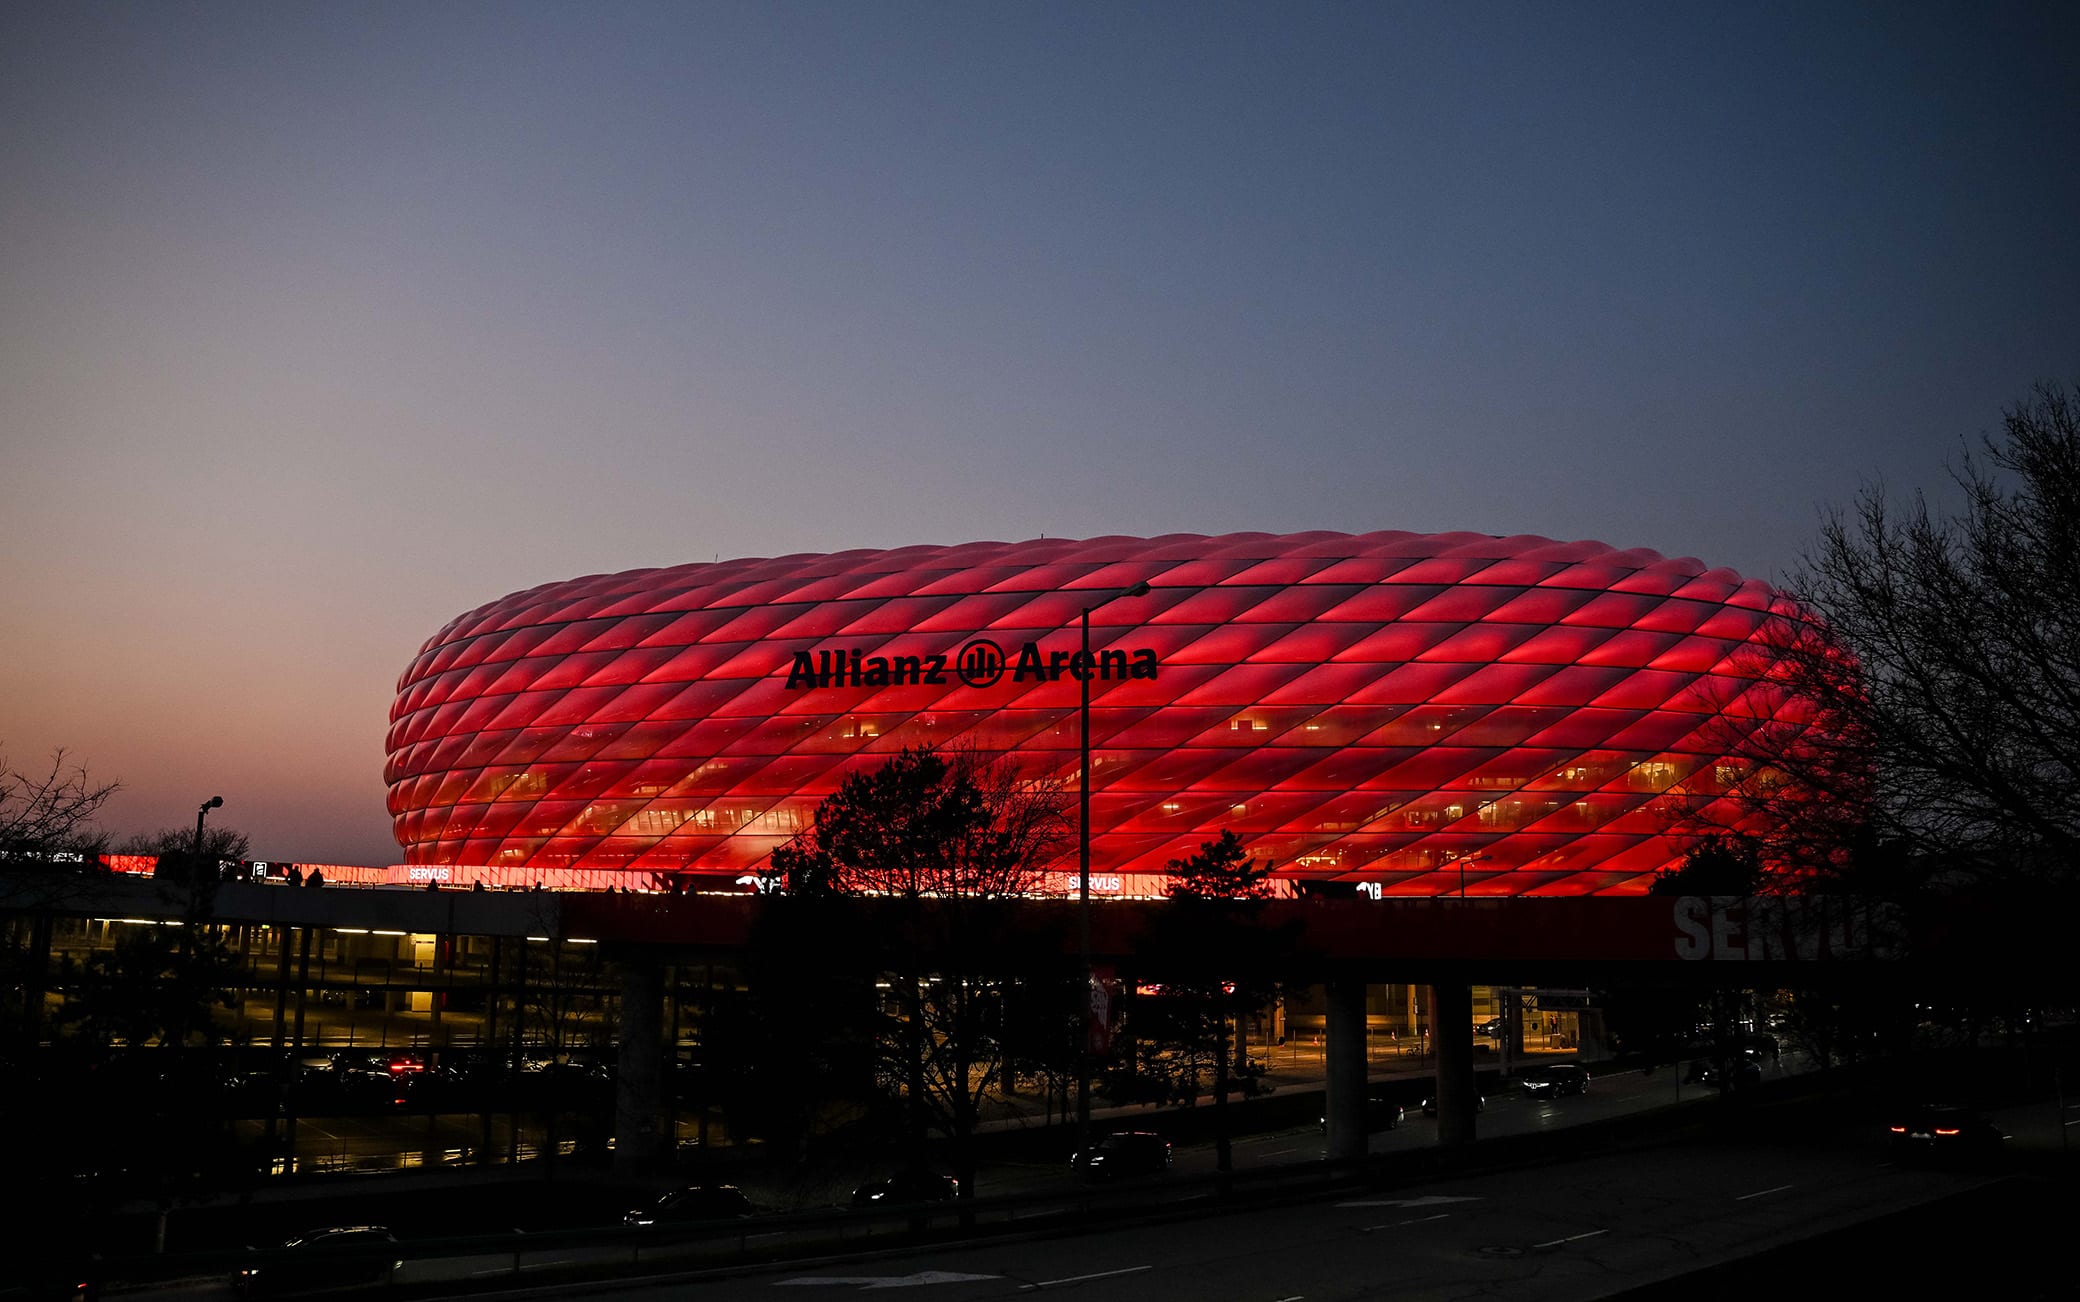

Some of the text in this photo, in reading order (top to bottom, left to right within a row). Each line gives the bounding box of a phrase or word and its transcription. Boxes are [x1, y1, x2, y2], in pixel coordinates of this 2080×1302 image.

[785, 642, 1158, 690] Allianz Arena
[410, 868, 449, 880] SERVUS
[1673, 896, 1911, 961] SERVUS
